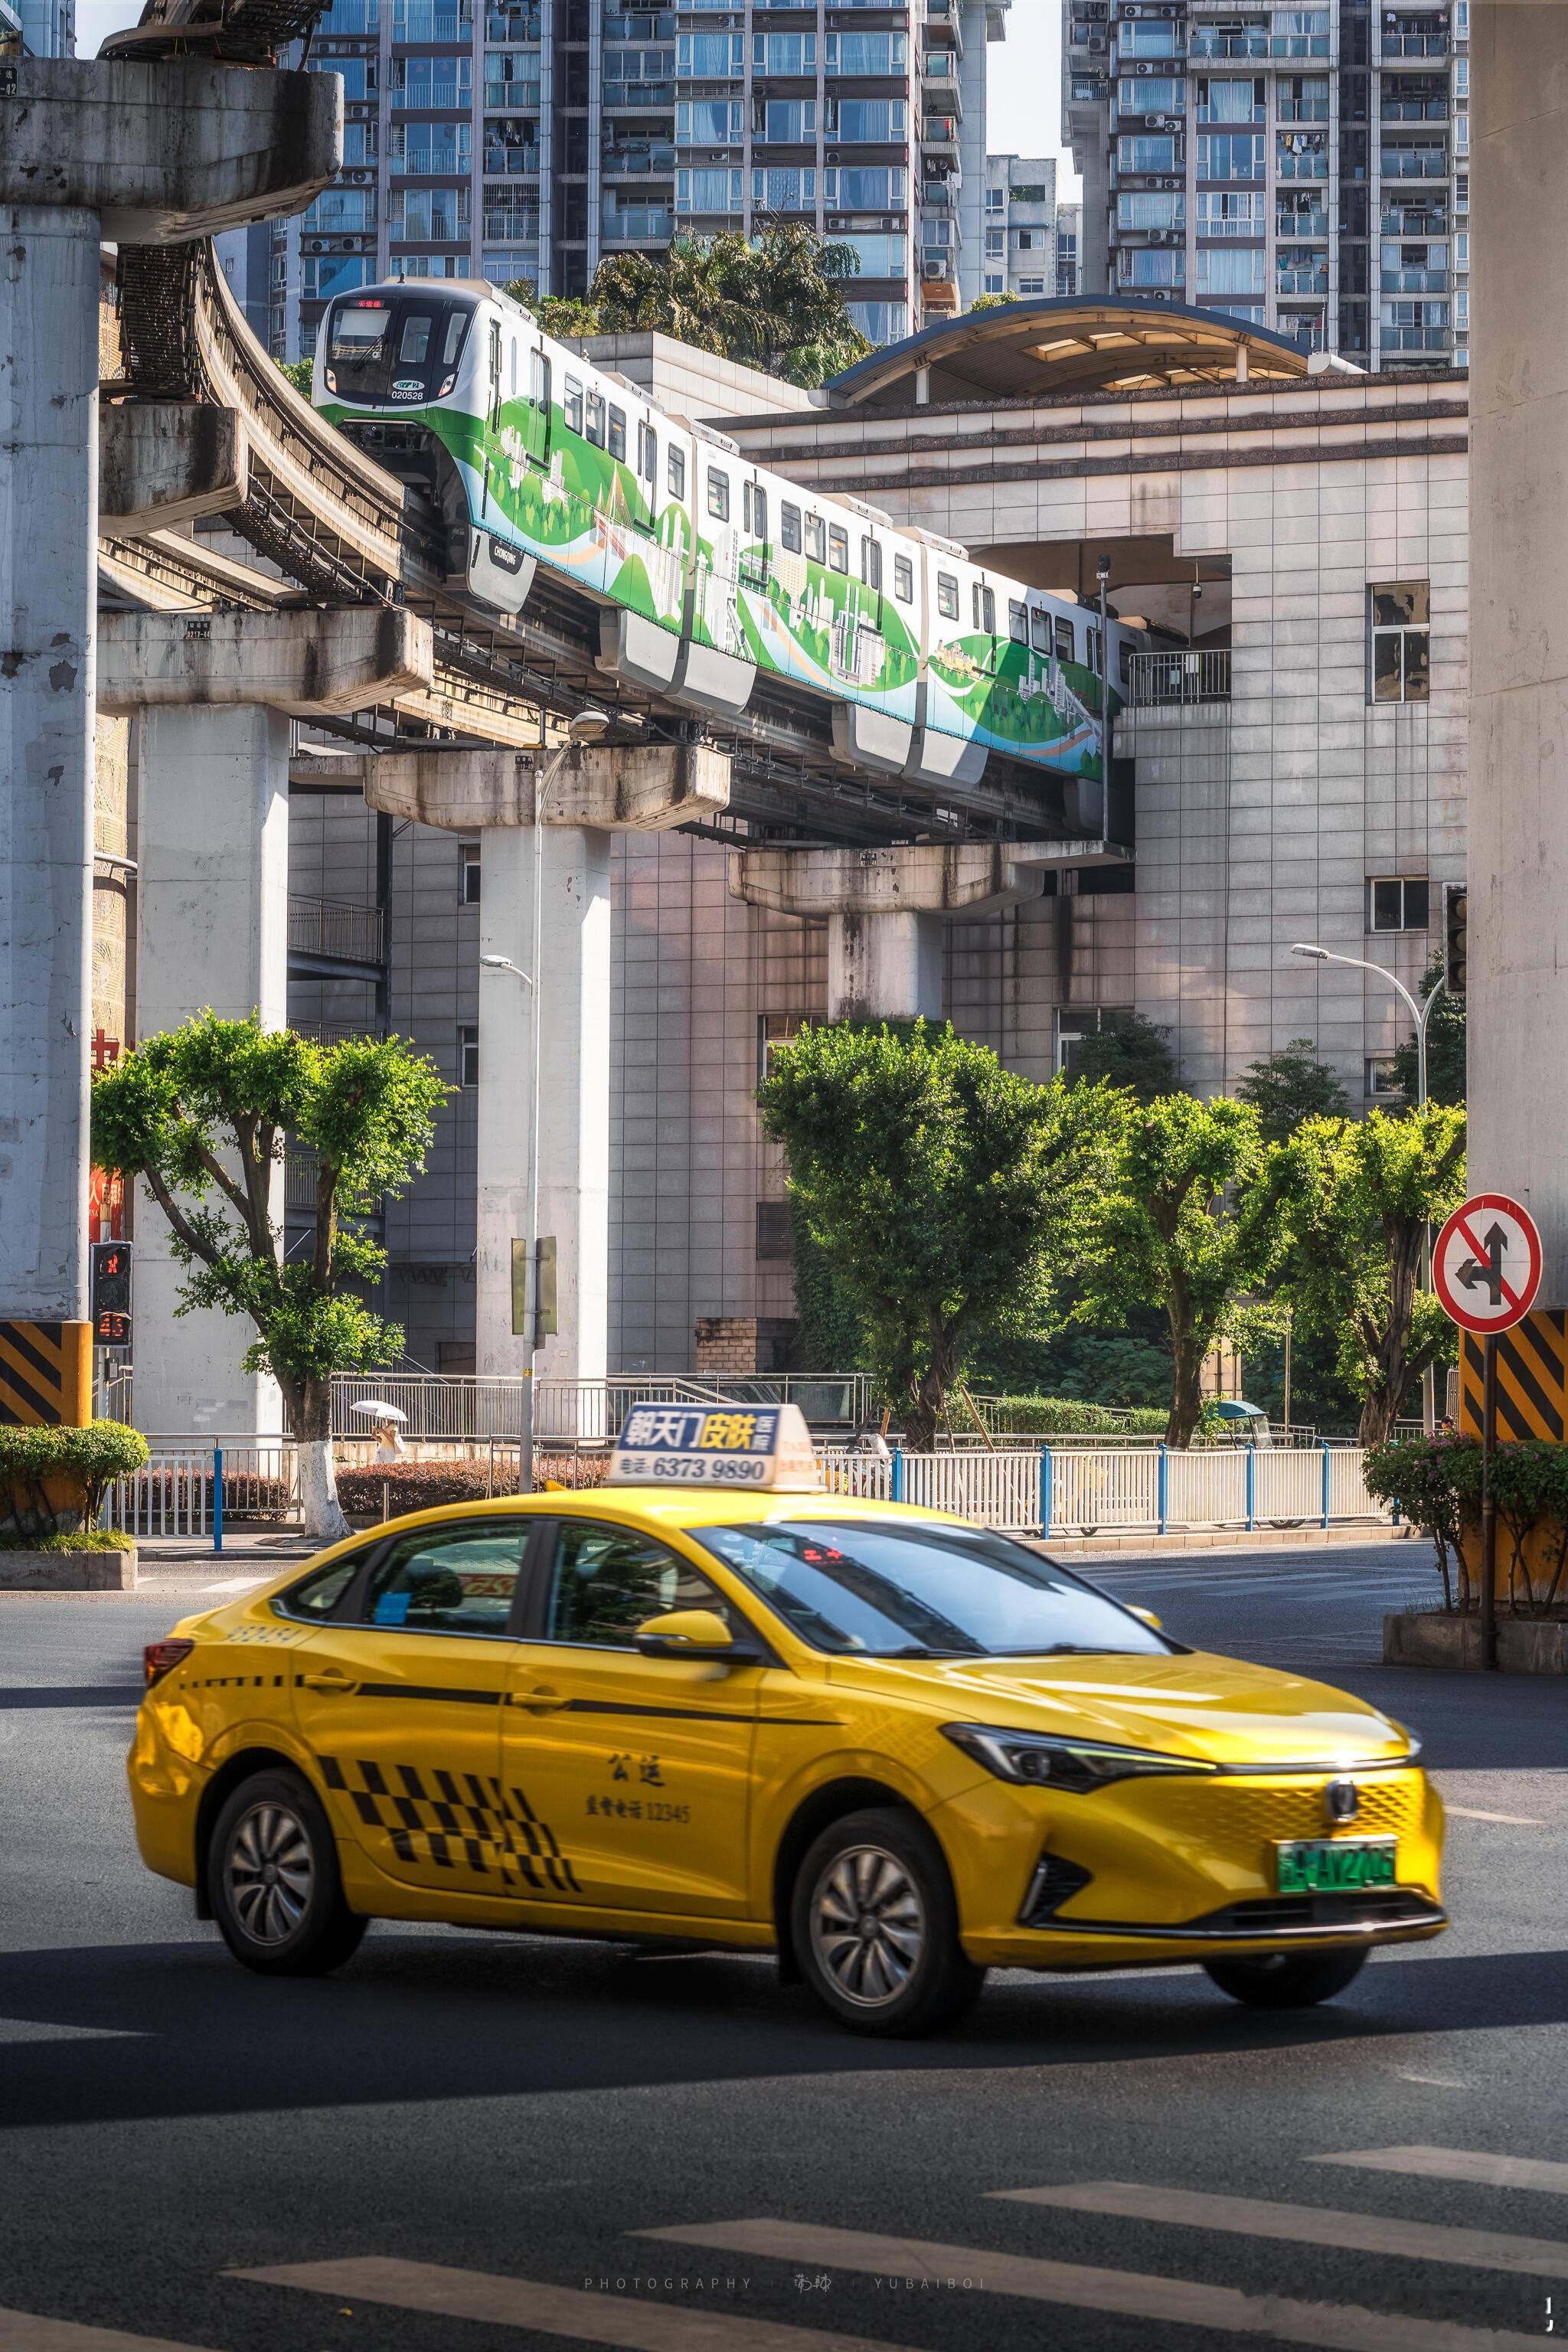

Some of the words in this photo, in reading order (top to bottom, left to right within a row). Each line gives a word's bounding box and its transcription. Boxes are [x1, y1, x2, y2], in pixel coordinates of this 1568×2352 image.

[391, 390, 423, 400] 020528
[494, 545, 517, 566] CHONGQING
[652, 1456, 705, 1478] 6373
[710, 1458, 766, 1481] 9890
